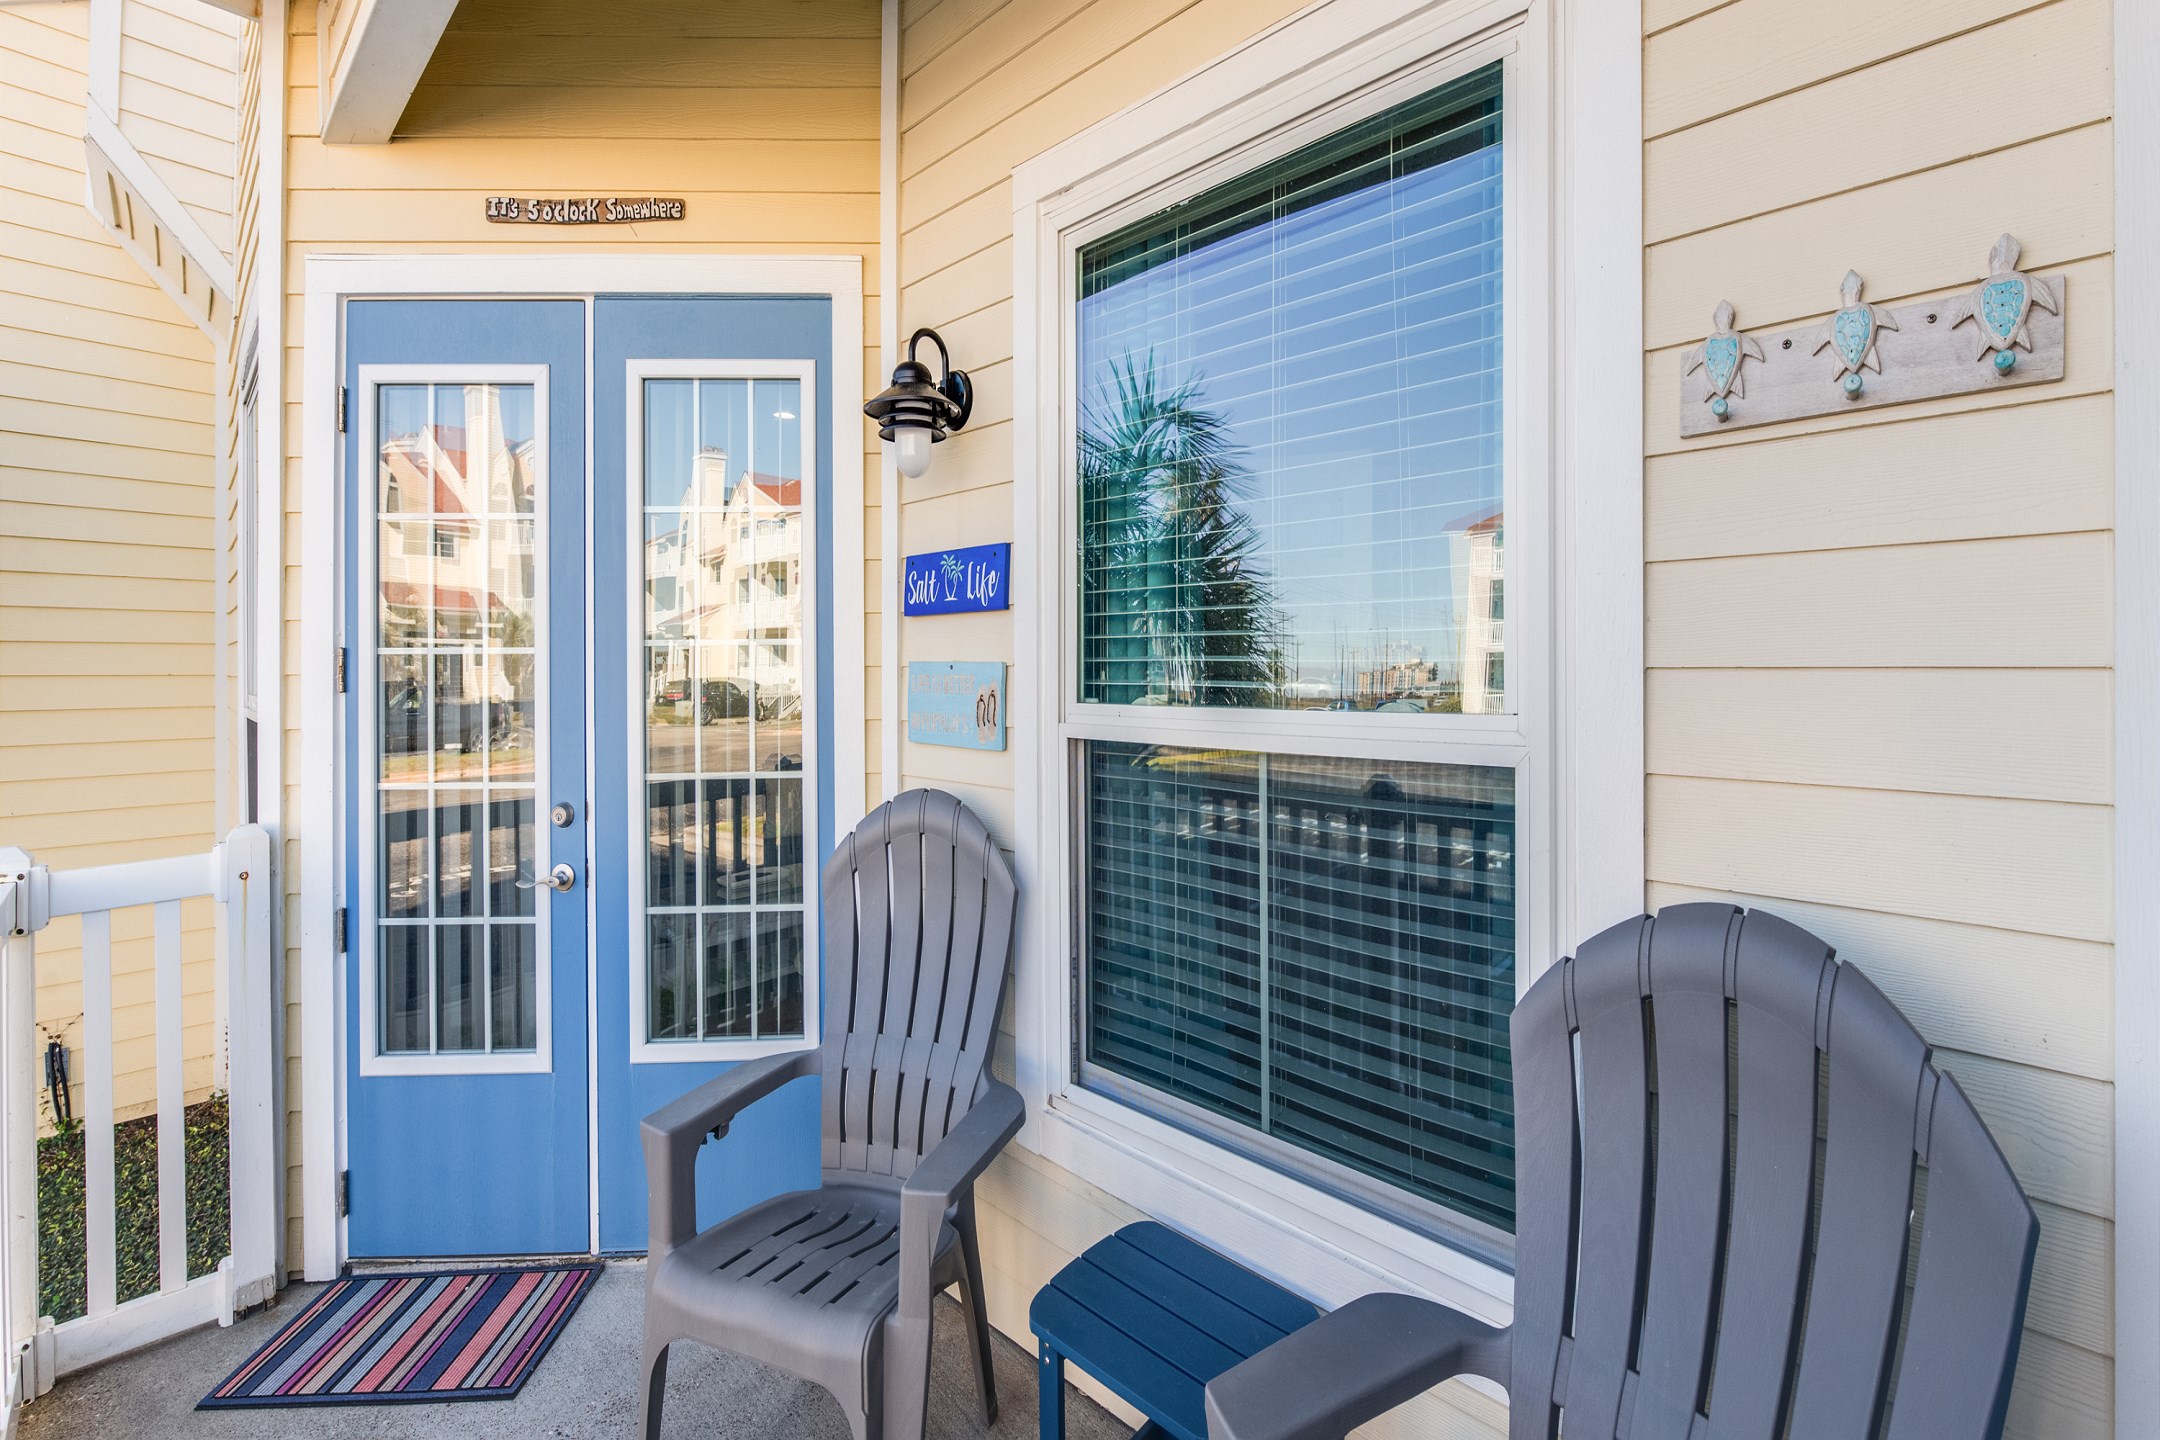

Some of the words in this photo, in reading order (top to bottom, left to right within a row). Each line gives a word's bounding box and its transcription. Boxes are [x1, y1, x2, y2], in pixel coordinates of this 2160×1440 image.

[528, 199, 540, 222] 5
[908, 570, 940, 605] Salt
[966, 561, 1000, 607] Life
